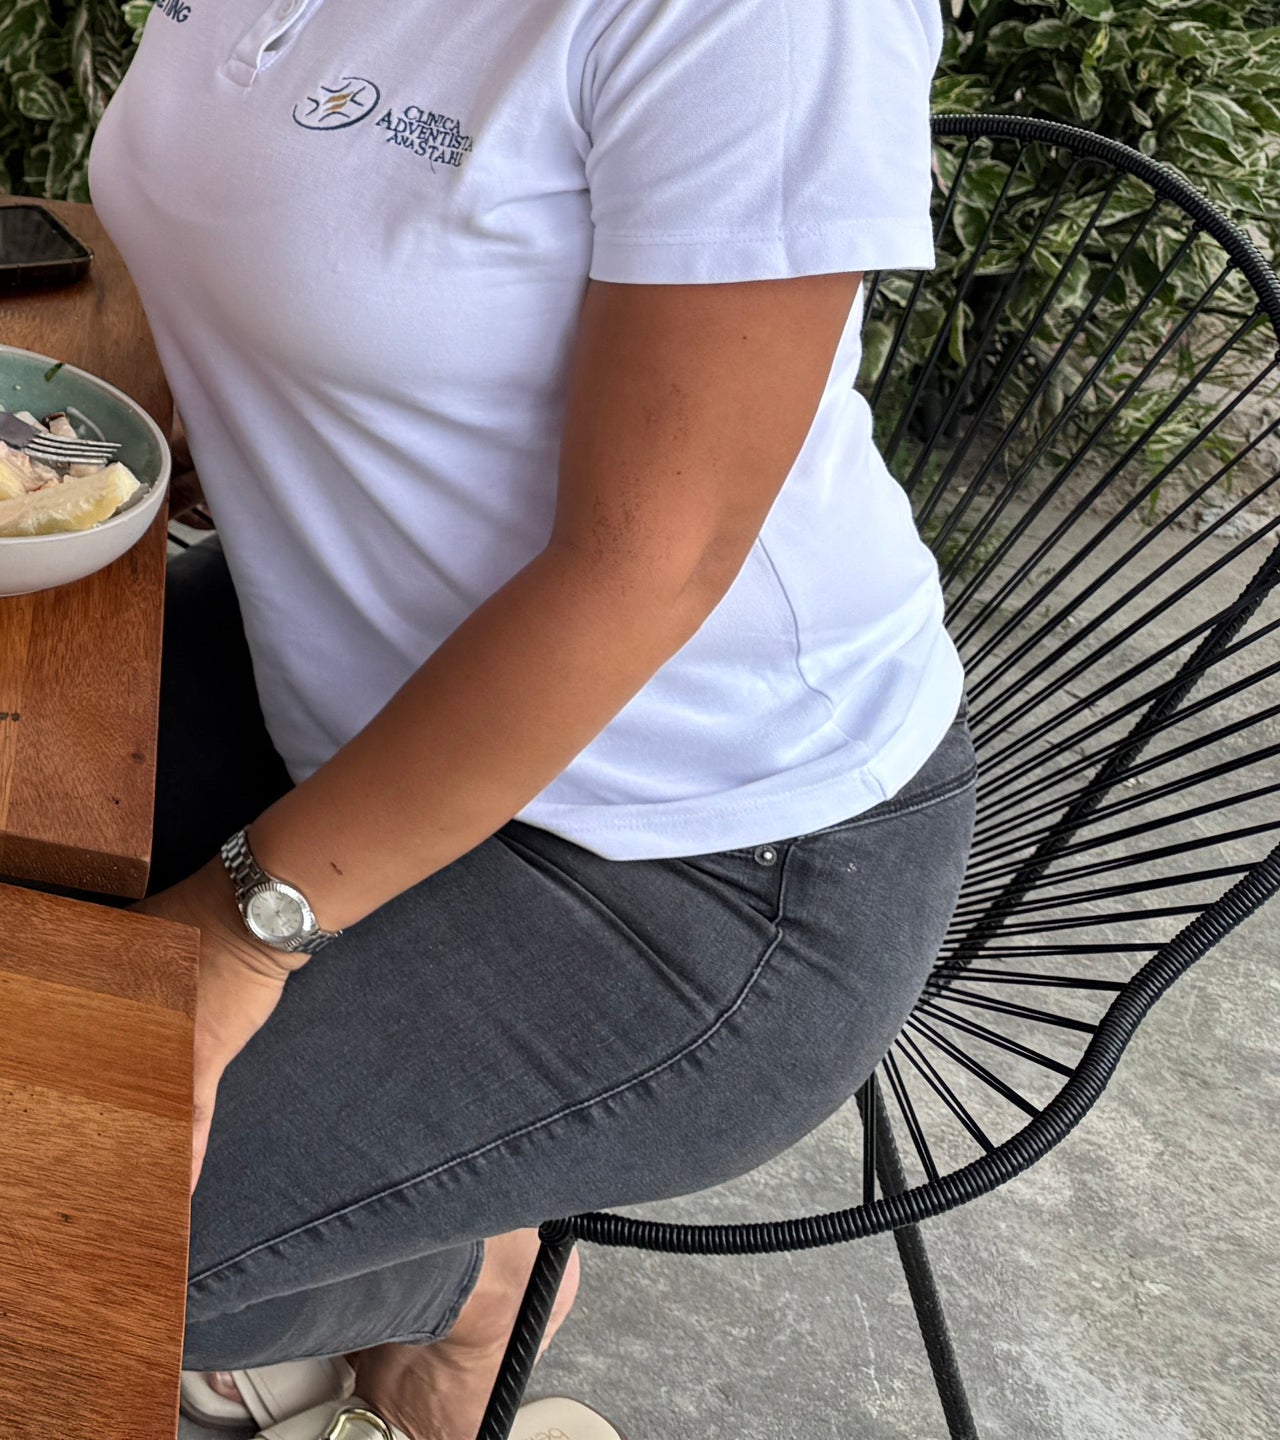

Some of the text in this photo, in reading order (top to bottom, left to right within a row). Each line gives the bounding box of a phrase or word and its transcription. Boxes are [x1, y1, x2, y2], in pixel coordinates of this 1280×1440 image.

[375, 107, 474, 153] ADVENTISTA
[403, 104, 461, 135] CLINICA
[385, 132, 415, 151] ANA
